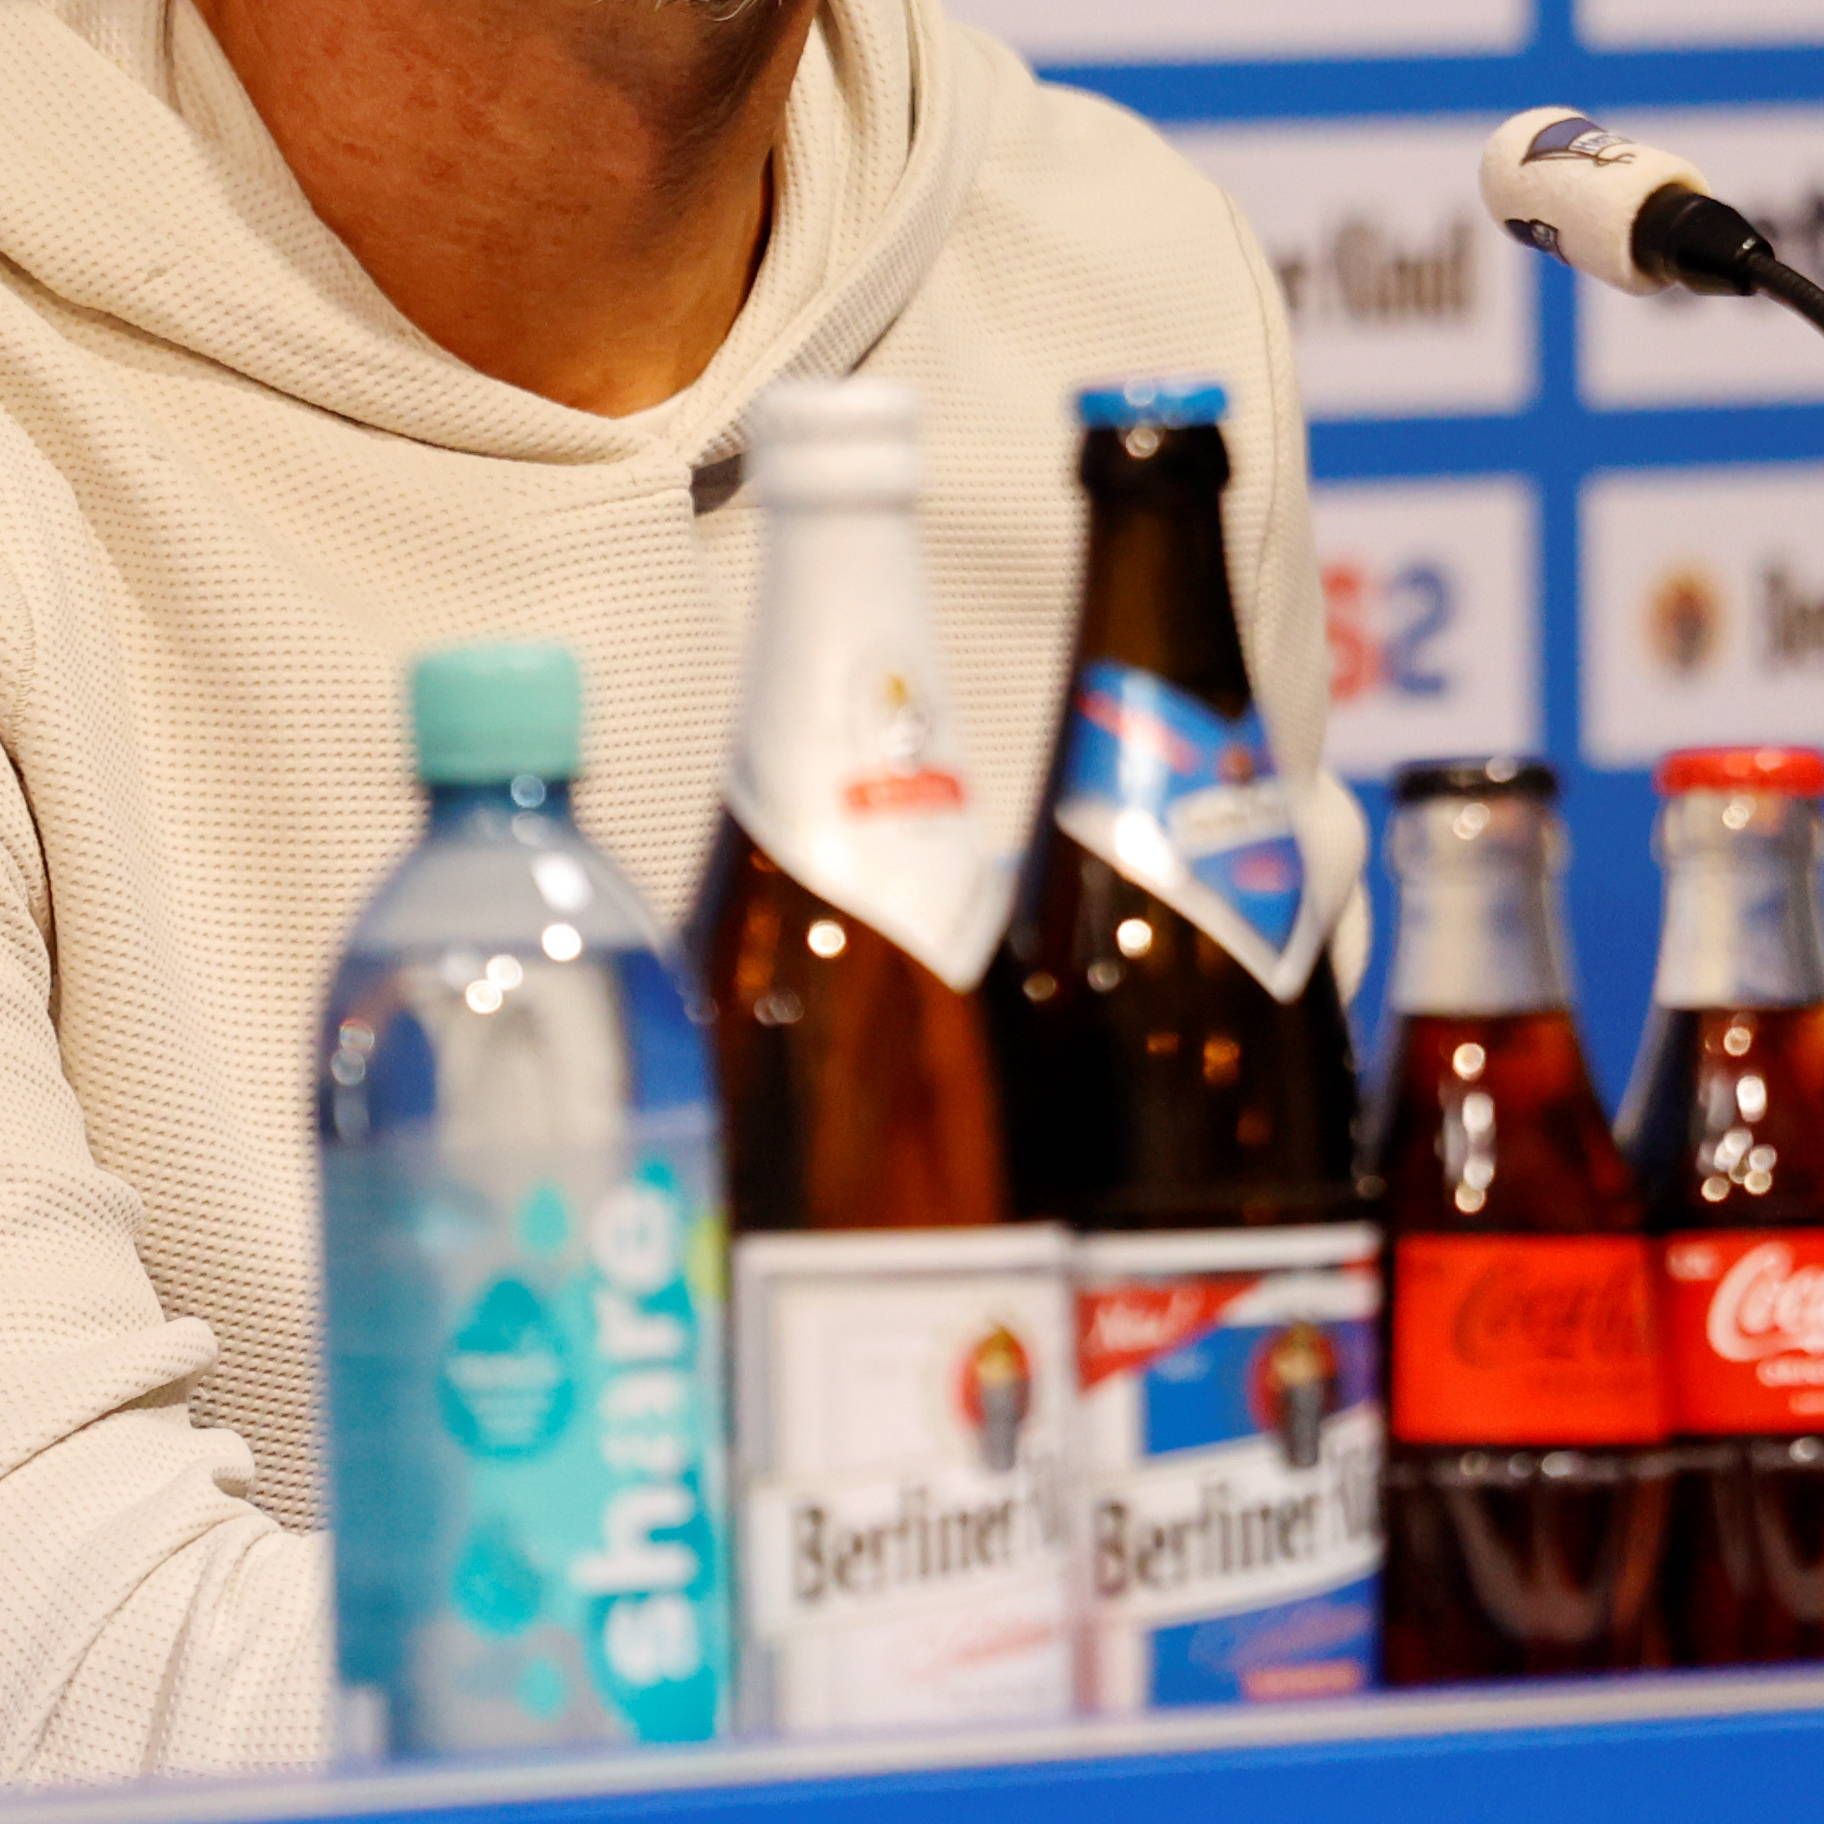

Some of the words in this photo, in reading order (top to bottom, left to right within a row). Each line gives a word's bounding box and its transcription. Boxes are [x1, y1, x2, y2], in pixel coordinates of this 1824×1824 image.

[566, 1184, 702, 1688] share
[793, 1479, 1021, 1606] Berliner
[1091, 1479, 1323, 1604] Berliner
